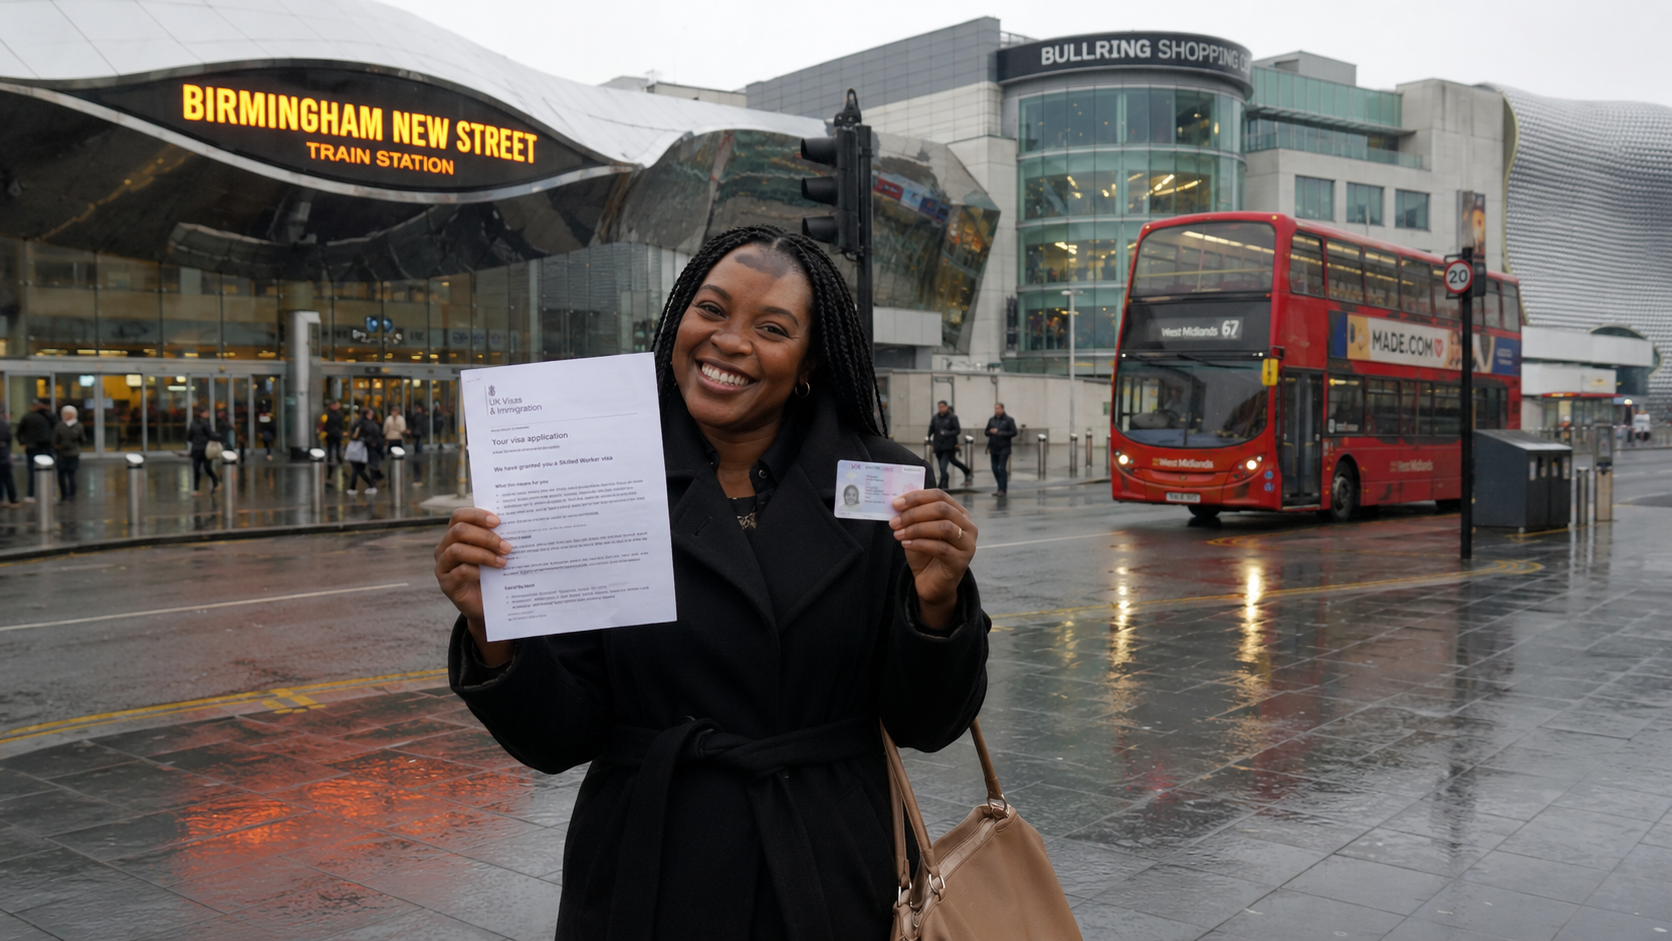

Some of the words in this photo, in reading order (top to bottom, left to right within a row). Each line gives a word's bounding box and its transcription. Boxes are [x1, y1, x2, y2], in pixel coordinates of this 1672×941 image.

[1041, 39, 1151, 65] BULLRING
[1158, 39, 1239, 68] SHOPPING
[182, 83, 384, 141] BIRMINGHAM
[392, 110, 449, 149] NEW
[456, 120, 538, 163] STREET
[306, 141, 371, 165] TRAIN
[375, 149, 455, 175] STATION
[1448, 269, 1468, 284] 20
[1161, 326, 1182, 337] West
[1183, 324, 1219, 337] Midlands
[1222, 320, 1240, 336] 67
[1372, 329, 1434, 357] MADE.COM
[489, 398, 501, 406] UK
[489, 407, 496, 415] &
[492, 438, 509, 446] Your
[510, 436, 526, 444] visa
[527, 432, 569, 443] application
[519, 462, 541, 471] granted
[579, 456, 600, 464] Worker
